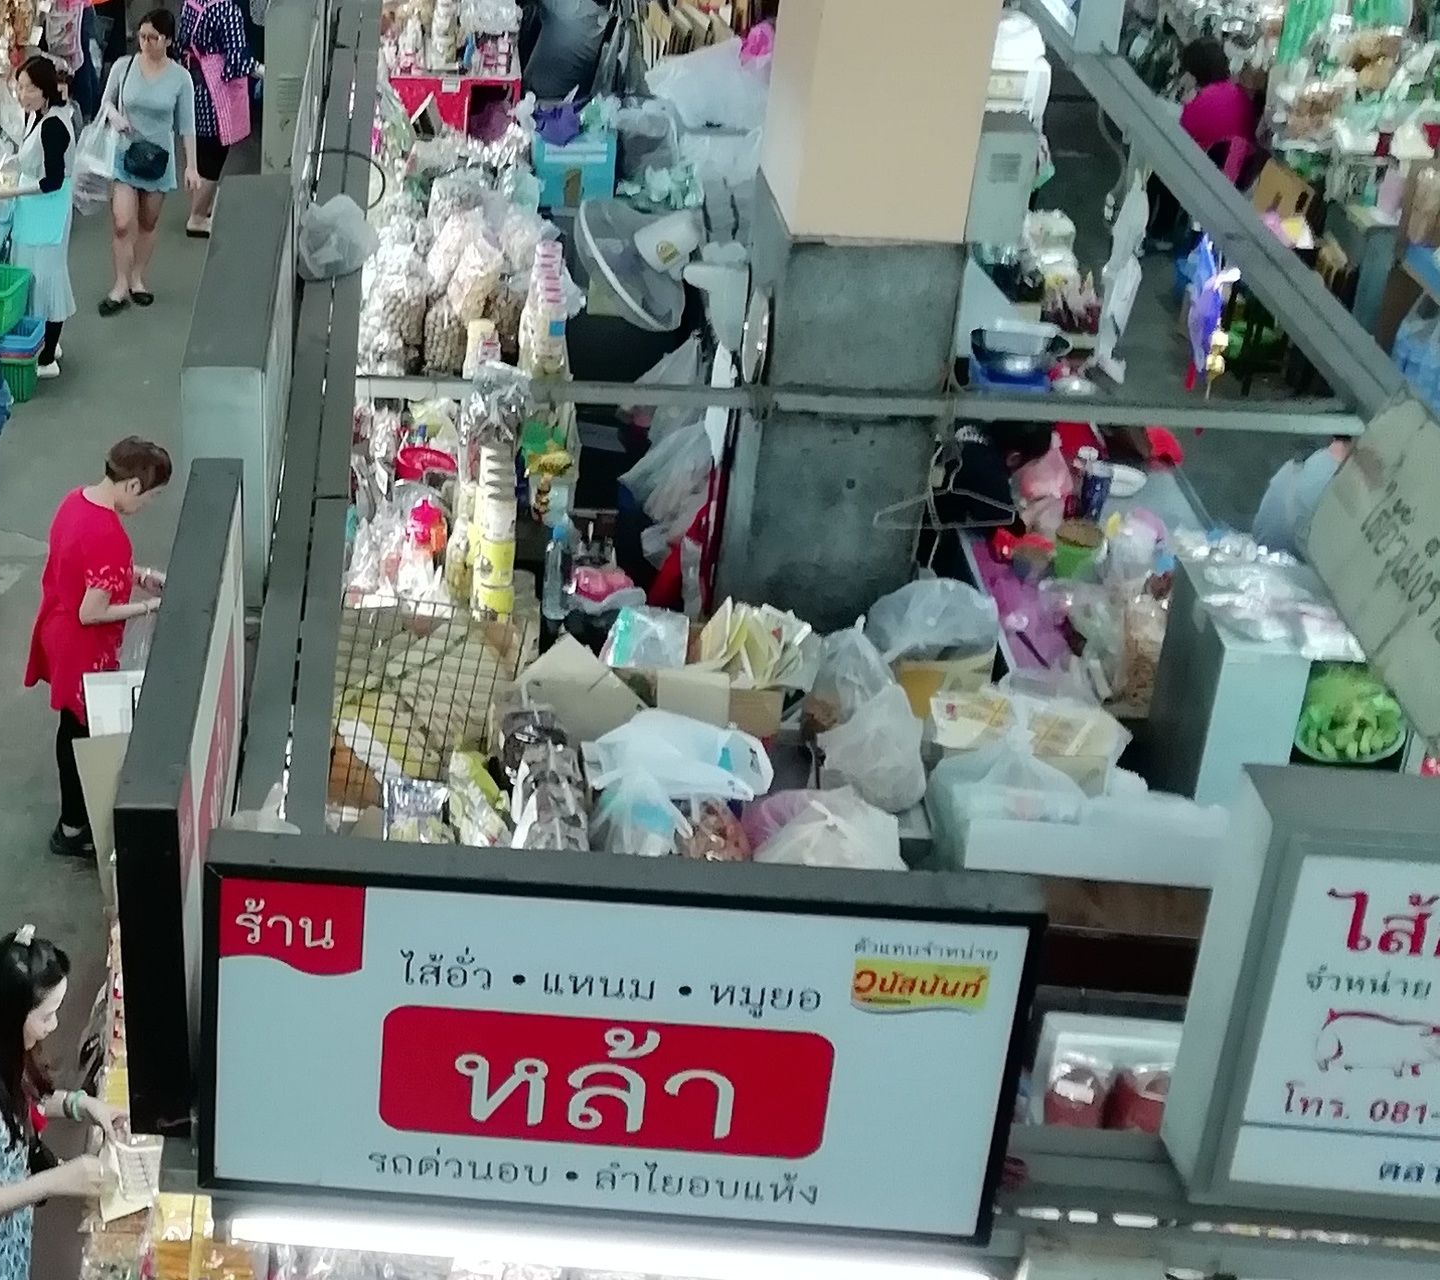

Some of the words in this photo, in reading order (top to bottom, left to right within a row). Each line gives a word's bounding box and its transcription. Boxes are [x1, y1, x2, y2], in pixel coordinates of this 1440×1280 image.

[235, 897, 335, 950] ร้าน
[400, 948, 494, 993] ไส้อั่ว
[542, 964, 658, 1004] แหนม
[708, 977, 824, 1020] หมูยอ
[1305, 967, 1433, 1000] จำหน่าย
[452, 1026, 738, 1141] หล้า
[1283, 1079, 1350, 1120] โทร.
[368, 1147, 550, 1190] รถด่วนอบ
[594, 1160, 821, 1207] ลำไยอบแห้ง
